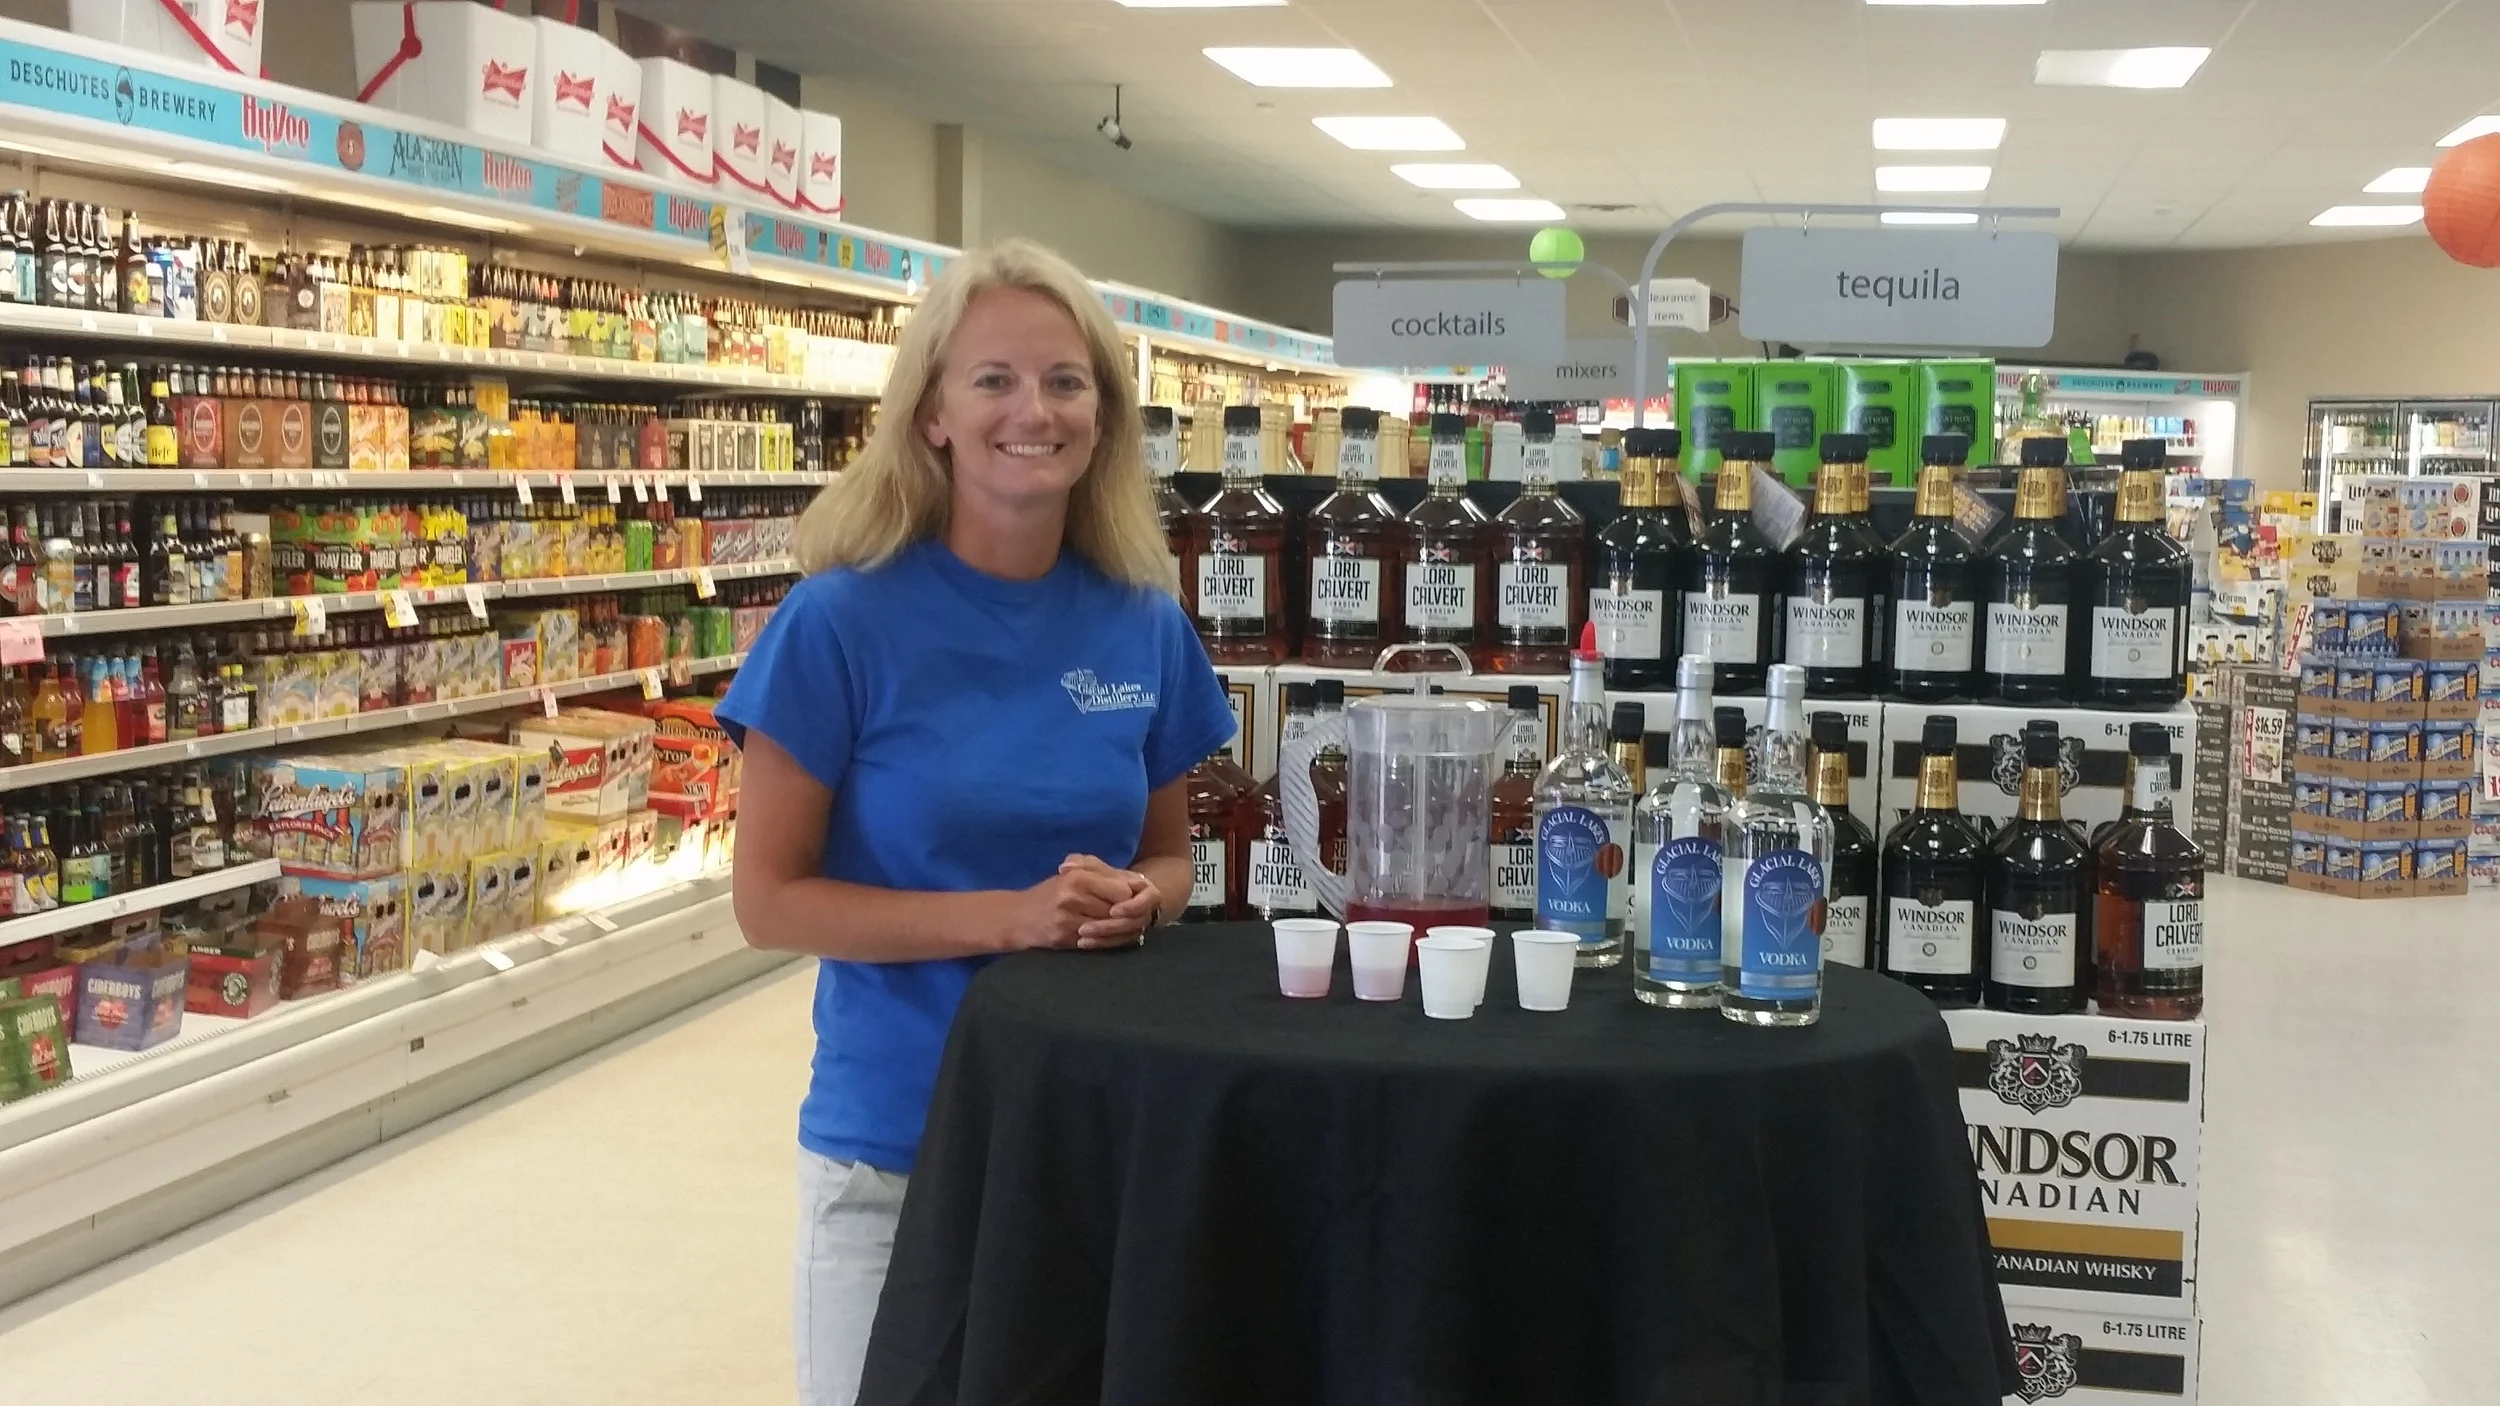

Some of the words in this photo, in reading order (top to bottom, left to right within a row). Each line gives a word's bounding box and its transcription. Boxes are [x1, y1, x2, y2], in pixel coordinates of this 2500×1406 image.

[10, 59, 110, 100] DESCHUTES
[139, 85, 217, 122] BREWERY
[389, 130, 464, 187] ALASKAN
[1836, 268, 1960, 307] tequila
[1648, 293, 1697, 304] learance
[1390, 310, 1506, 337] cocktails
[1653, 311, 1685, 322] items
[1556, 361, 1618, 380] mixers
[1344, 443, 1361, 453] LORD
[1437, 449, 1455, 458] LORD
[1529, 448, 1546, 457] LORD
[1341, 453, 1366, 464] CALVERT
[1433, 458, 1458, 469] CALVERT
[1525, 457, 1550, 469] CALVERT
[2263, 503, 2288, 514] Corona
[270, 550, 306, 569] AVELER
[313, 551, 363, 571] TRAVELER
[1212, 558, 1245, 575] LORD
[1327, 562, 1361, 579] LORD
[1422, 567, 1456, 586] LORD
[1515, 566, 1549, 584] LORD
[1203, 577, 1255, 598] CALVERT
[1317, 580, 1371, 601] CALVERT
[1505, 585, 1559, 607] CALVERT
[1412, 586, 1466, 608] CALVERT
[1593, 597, 1653, 614] WINDSOR
[2218, 591, 2247, 605] Corona
[1597, 612, 1646, 621] CANADIAN
[1689, 601, 1750, 617] WINDSOR
[1792, 604, 1856, 620] WINDSOR
[1906, 609, 1968, 625] WINDSOR
[1693, 616, 1742, 624] CANADIAN
[1797, 619, 1848, 628] CANADIAN
[1911, 624, 1963, 632] CANADIAN
[1994, 612, 2060, 628] WINDSOR
[2101, 615, 2167, 631] WINDSOR
[1999, 627, 2052, 635] CANADIAN
[2107, 631, 2160, 639] CANADIAN
[1110, 681, 1142, 694] Lakes
[1849, 713, 1869, 728] TRE
[2255, 715, 2284, 736] $16.59
[1516, 724, 1534, 735] LORD
[2104, 723, 2129, 738] 6-1.
[268, 820, 312, 833] EXPLORER
[1540, 810, 1577, 842] GLACIAL
[1579, 813, 1606, 845] LAKES
[1192, 844, 1208, 863] RD
[1509, 847, 1534, 866] LOR
[1656, 842, 1701, 876] GLACIAL
[1497, 867, 1534, 888] CALV
[1749, 855, 1796, 888] GLACIAL
[1797, 857, 1822, 890] LAKES
[1547, 897, 1592, 914] VODKA
[1828, 906, 1861, 919] DSOR
[2168, 902, 2199, 923] LORD
[1829, 920, 1853, 928] DIAN
[1898, 907, 1966, 924] WINDSOR
[1903, 923, 1958, 932] CANADIAN
[1999, 920, 2068, 937] WINDSOR
[1665, 936, 1714, 950] VODKA
[2004, 936, 2059, 946] CANADIAN
[1758, 952, 1808, 967] VODKA
[87, 977, 143, 1001] CIDERBOYS
[2108, 1028, 2149, 1046] 6-1.75
[2153, 1032, 2193, 1048] LITRE
[1970, 1124, 2182, 1187] NDSOR
[1980, 1178, 2141, 1216] NADIAN
[1993, 1254, 2079, 1276] ANADIAN
[2086, 1261, 2157, 1282] WHISKY
[2102, 1320, 2143, 1338] 6-1.75
[2147, 1324, 2187, 1341] LITRE
